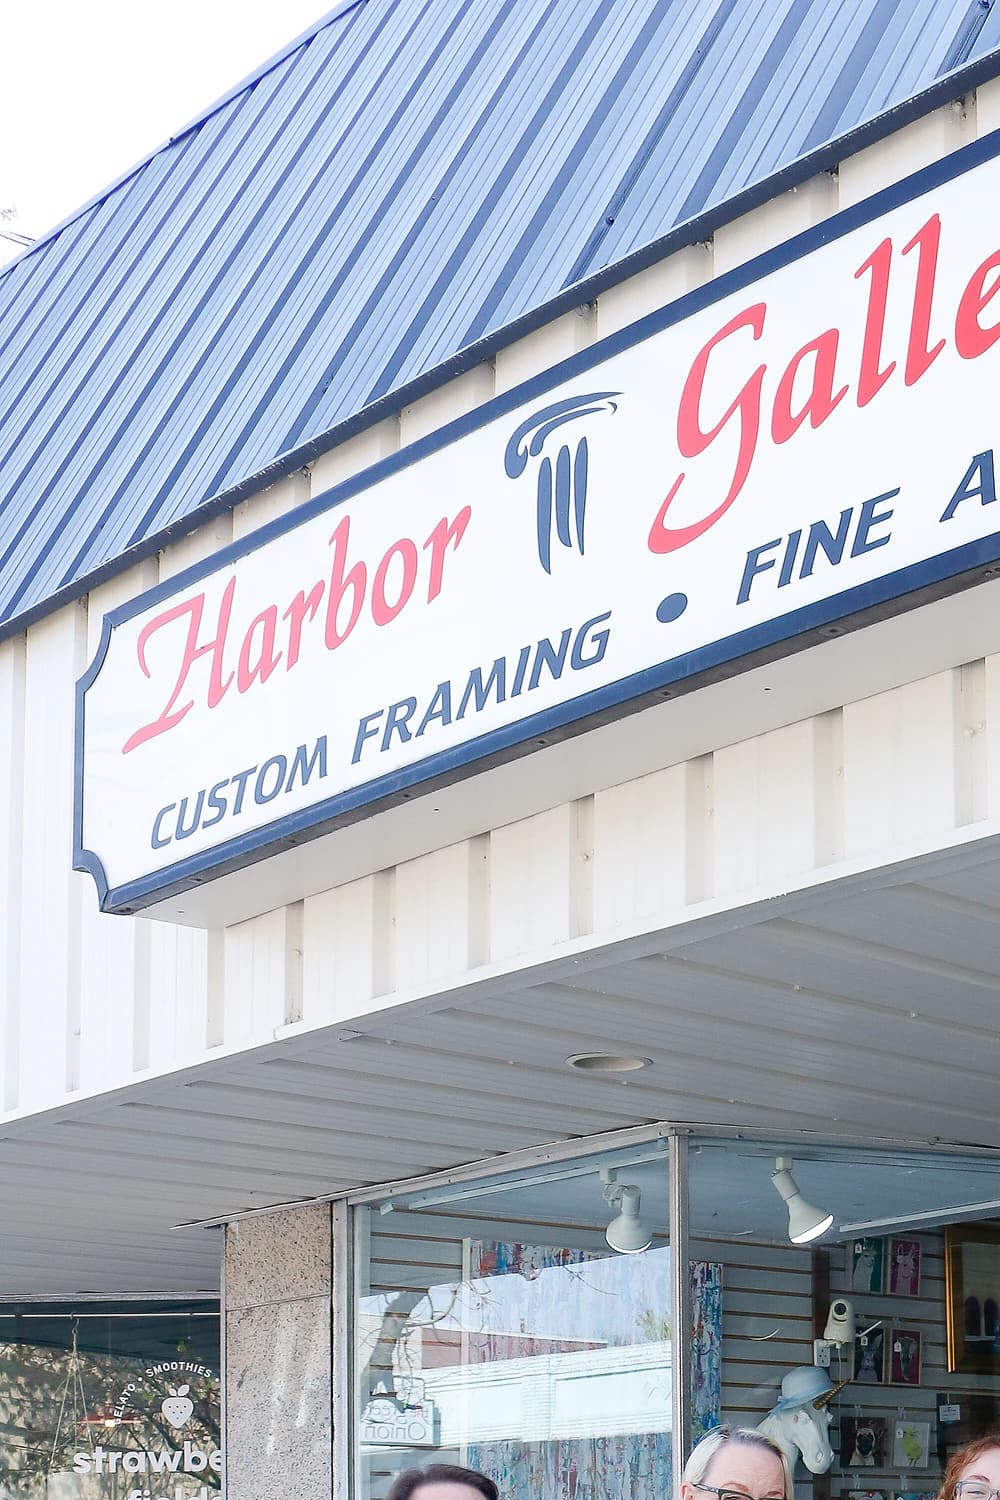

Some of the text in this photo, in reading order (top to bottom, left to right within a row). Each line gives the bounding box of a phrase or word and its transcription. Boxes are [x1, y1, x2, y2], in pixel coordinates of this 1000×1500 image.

[122, 505, 471, 754] Harbor
[150, 736, 328, 849] CUSTOM
[351, 610, 612, 765] FRAMING
[737, 486, 901, 605] FINE
[145, 1361, 212, 1378] SMOOTHIES
